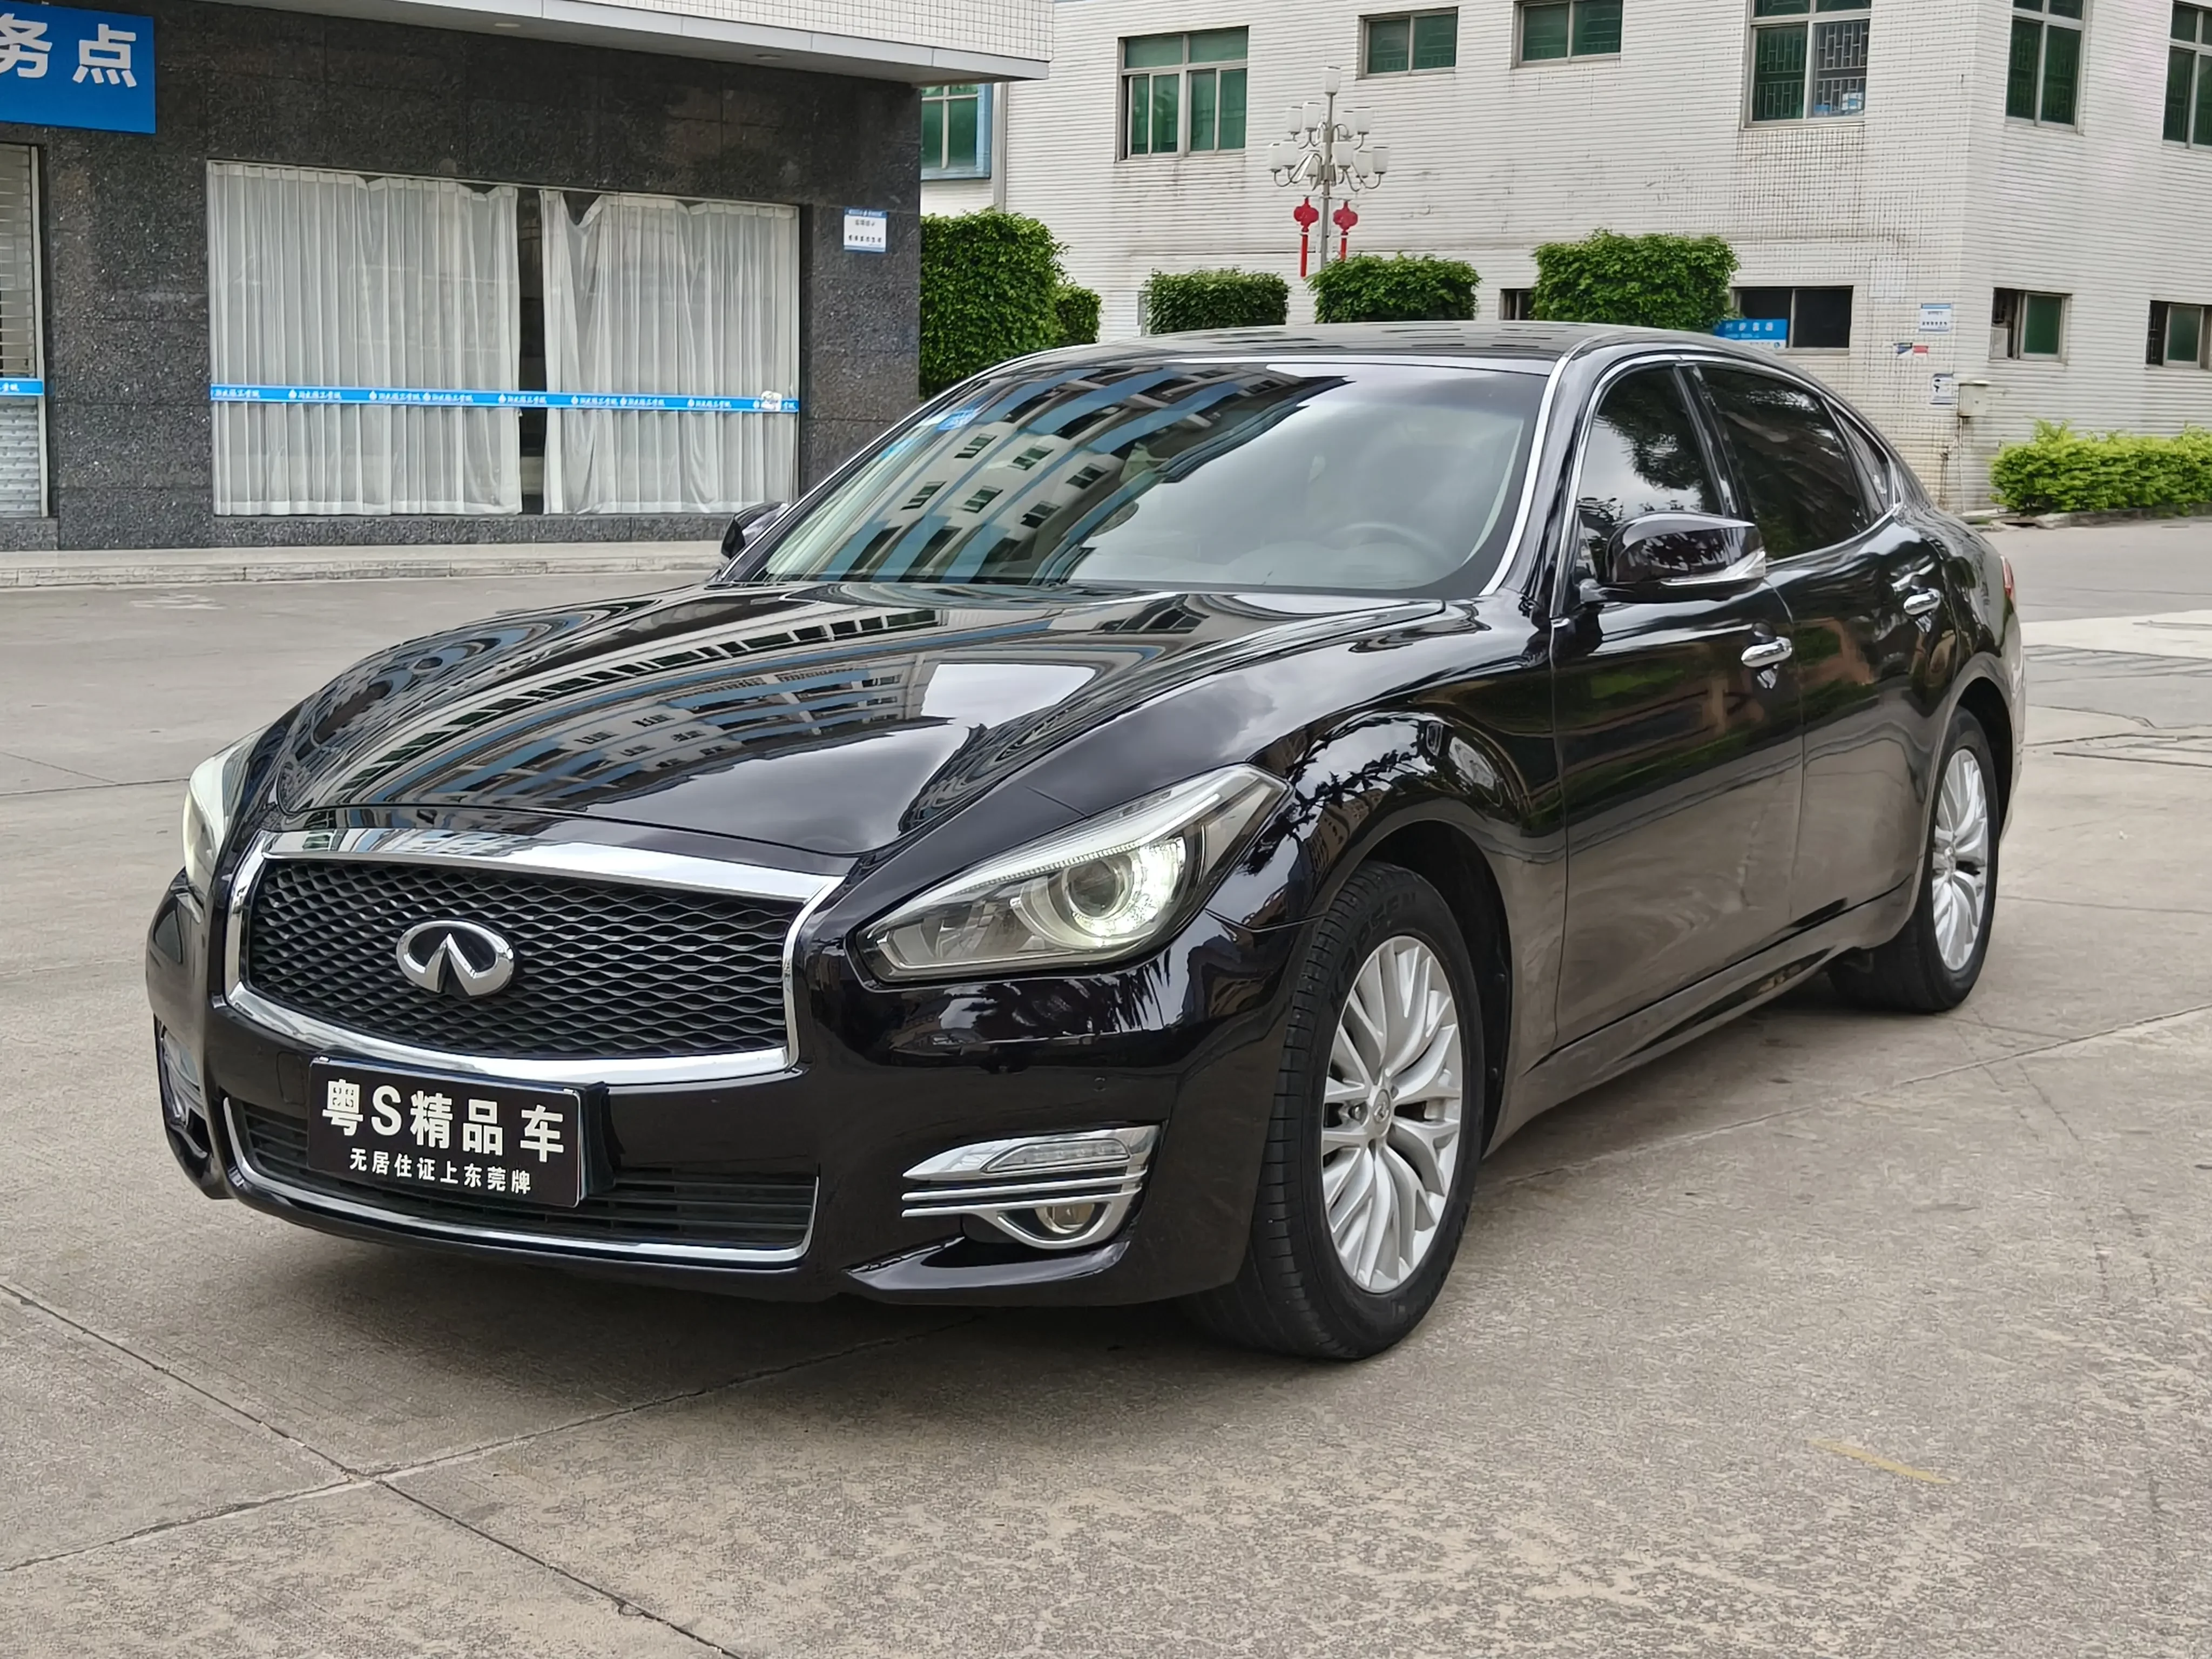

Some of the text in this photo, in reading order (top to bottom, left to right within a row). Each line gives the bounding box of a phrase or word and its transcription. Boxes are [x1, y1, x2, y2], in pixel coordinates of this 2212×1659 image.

[0, 13, 137, 87] 务点
[322, 1079, 564, 1163] 粤S精品车
[349, 1148, 531, 1195] 无居住证上东莞牌
